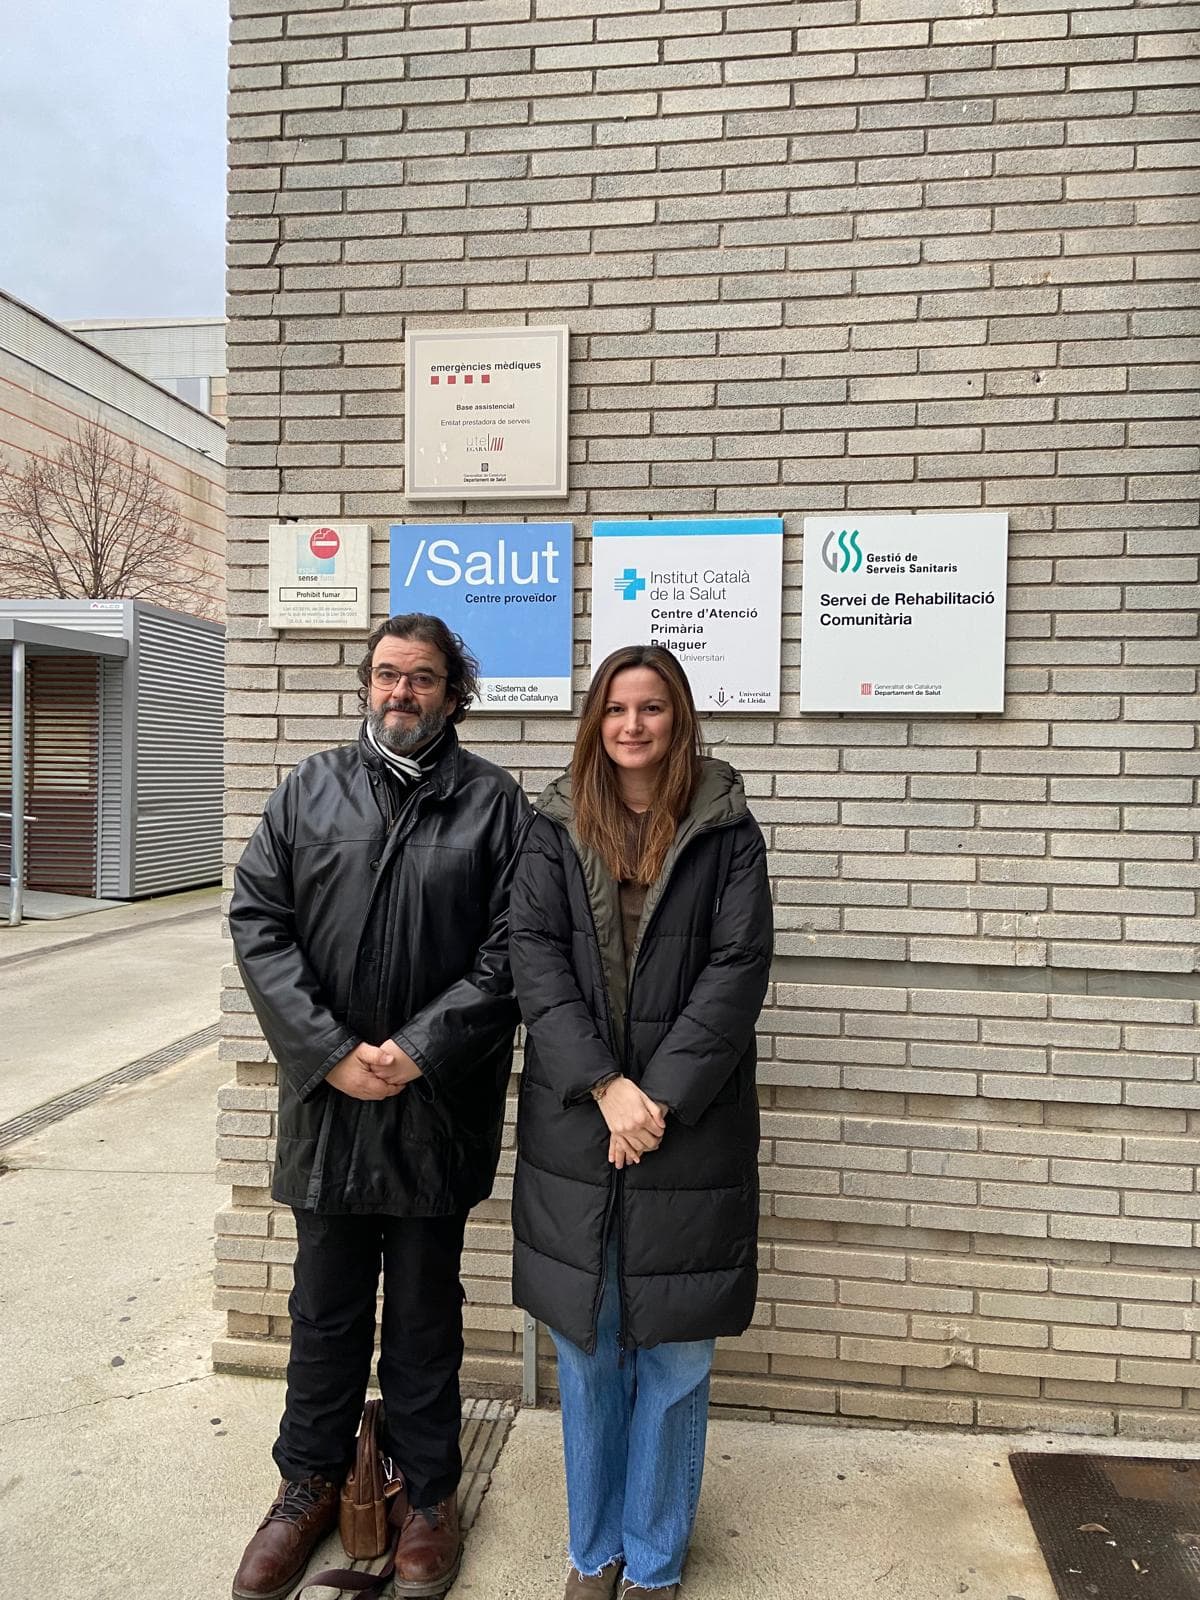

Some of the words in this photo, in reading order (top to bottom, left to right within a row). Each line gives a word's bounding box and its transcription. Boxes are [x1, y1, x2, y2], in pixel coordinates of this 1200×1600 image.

[430, 362, 492, 373] emergències
[494, 361, 541, 372] mèdiques
[462, 419, 496, 427] prestadora
[866, 553, 901, 563] Gestió
[905, 553, 918, 562] de
[866, 564, 905, 574] Serveis
[909, 563, 958, 573] Sanitaris
[650, 570, 698, 584] Institut
[703, 570, 750, 584] Català
[465, 593, 501, 604] Centre
[504, 593, 557, 605] proveïdor
[650, 587, 668, 600] de
[673, 587, 685, 600] la
[690, 587, 726, 600] Salut
[820, 593, 866, 606] Servei
[872, 593, 890, 606] de
[895, 591, 995, 605] Rehabilitació
[651, 609, 693, 619] Centre
[697, 608, 758, 619] d'Atenció
[820, 613, 912, 626] Comunitària
[651, 623, 704, 634] Primària
[680, 653, 724, 662] Universitari
[528, 684, 538, 692] de
[487, 694, 507, 702] Salut
[508, 694, 518, 702] de
[519, 693, 558, 704] Catalunya
